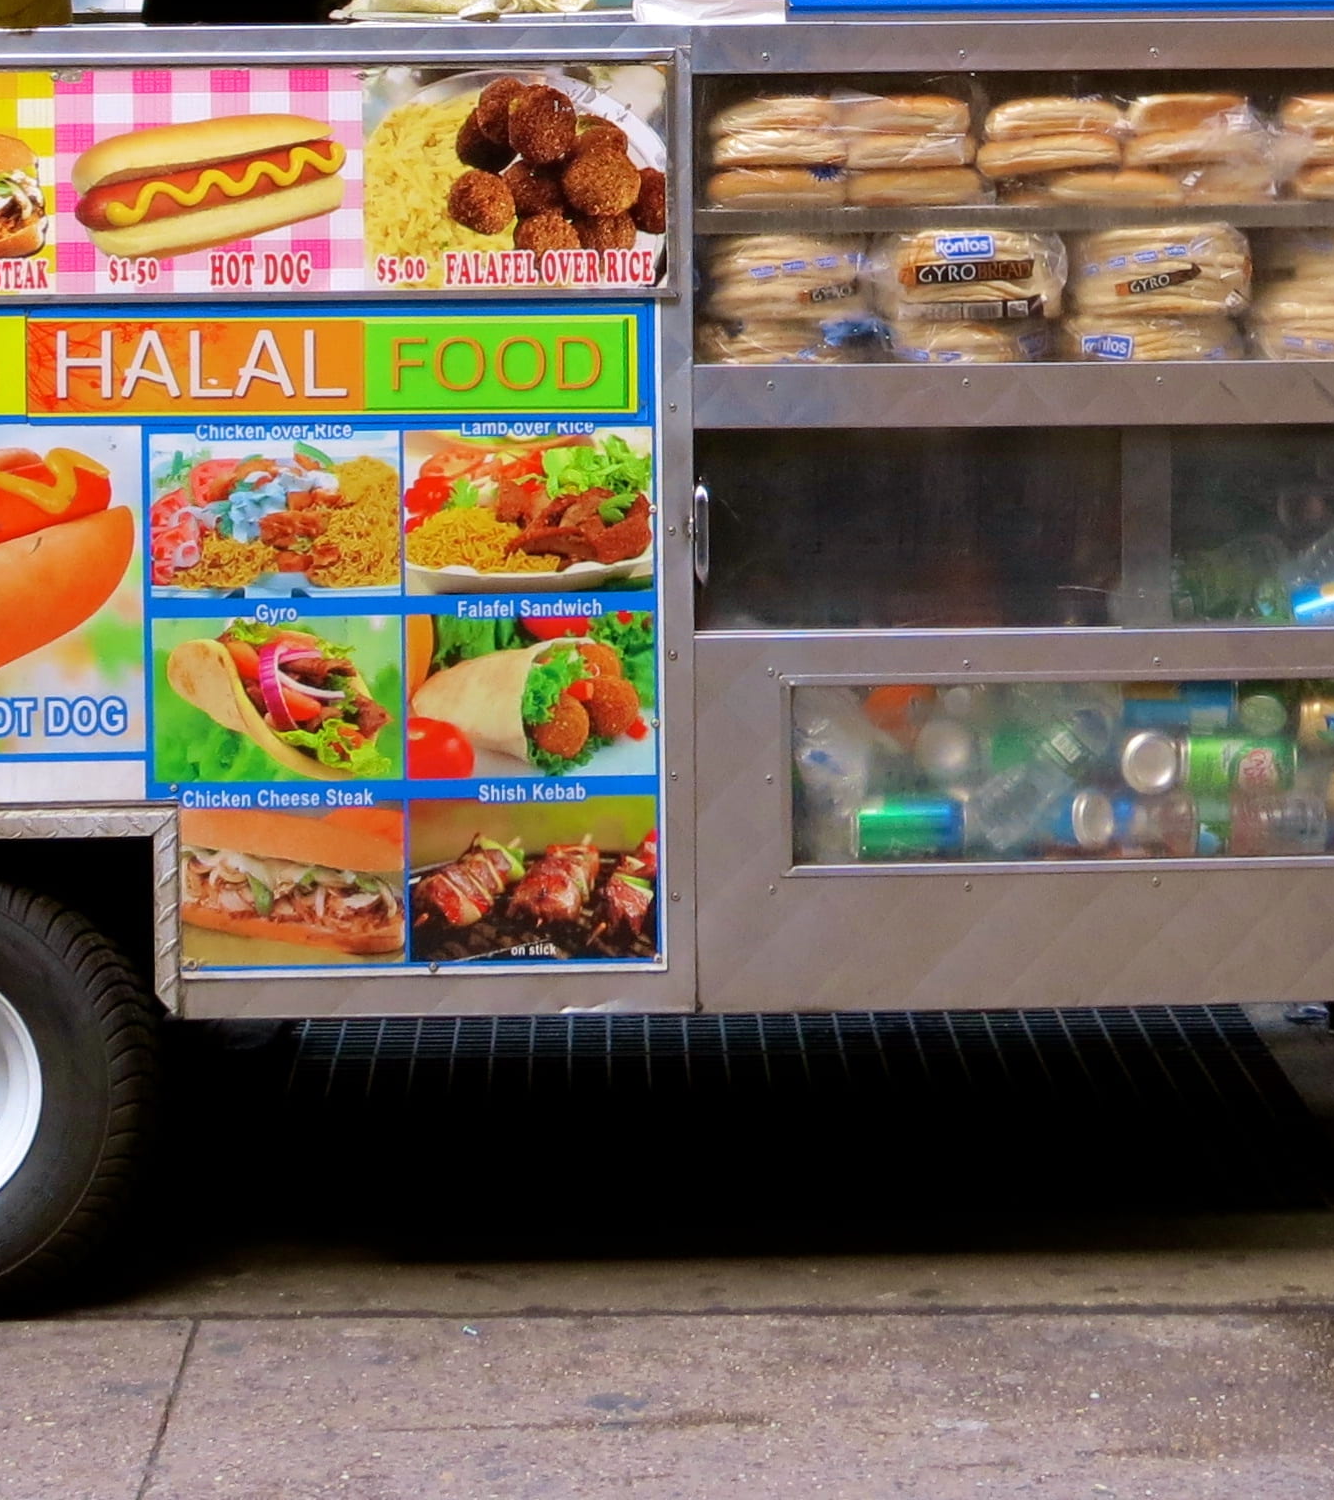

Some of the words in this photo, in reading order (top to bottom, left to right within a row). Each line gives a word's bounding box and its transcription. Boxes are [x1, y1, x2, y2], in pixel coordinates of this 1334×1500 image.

[936, 238, 989, 253] kontos
[110, 258, 158, 285] $1.50
[210, 255, 255, 287] HOT
[263, 254, 310, 287] DOG
[377, 257, 425, 284] $5.00
[445, 254, 536, 285] FALAFEL
[542, 252, 602, 285] OVER
[607, 251, 653, 284] RICE
[919, 264, 976, 282] GYRO
[1130, 275, 1169, 292] GYRO
[57, 329, 348, 401] HALAL
[390, 335, 603, 392] FOOD
[196, 424, 265, 439] Chicken
[271, 425, 309, 439] over
[314, 424, 352, 438] Rice
[461, 423, 507, 435] Lamb
[513, 422, 550, 434] over
[558, 422, 593, 434] Rice
[256, 605, 298, 626] Gyro
[457, 601, 515, 618] Falafel
[520, 599, 602, 616] Sandwich
[45, 696, 127, 735] DOG
[182, 790, 251, 808] Chicken
[257, 790, 320, 807] Cheese
[327, 789, 374, 805] Steak
[479, 785, 526, 803] Shish
[532, 784, 586, 800] Kebab
[511, 944, 525, 956] on
[529, 943, 557, 955] stick
